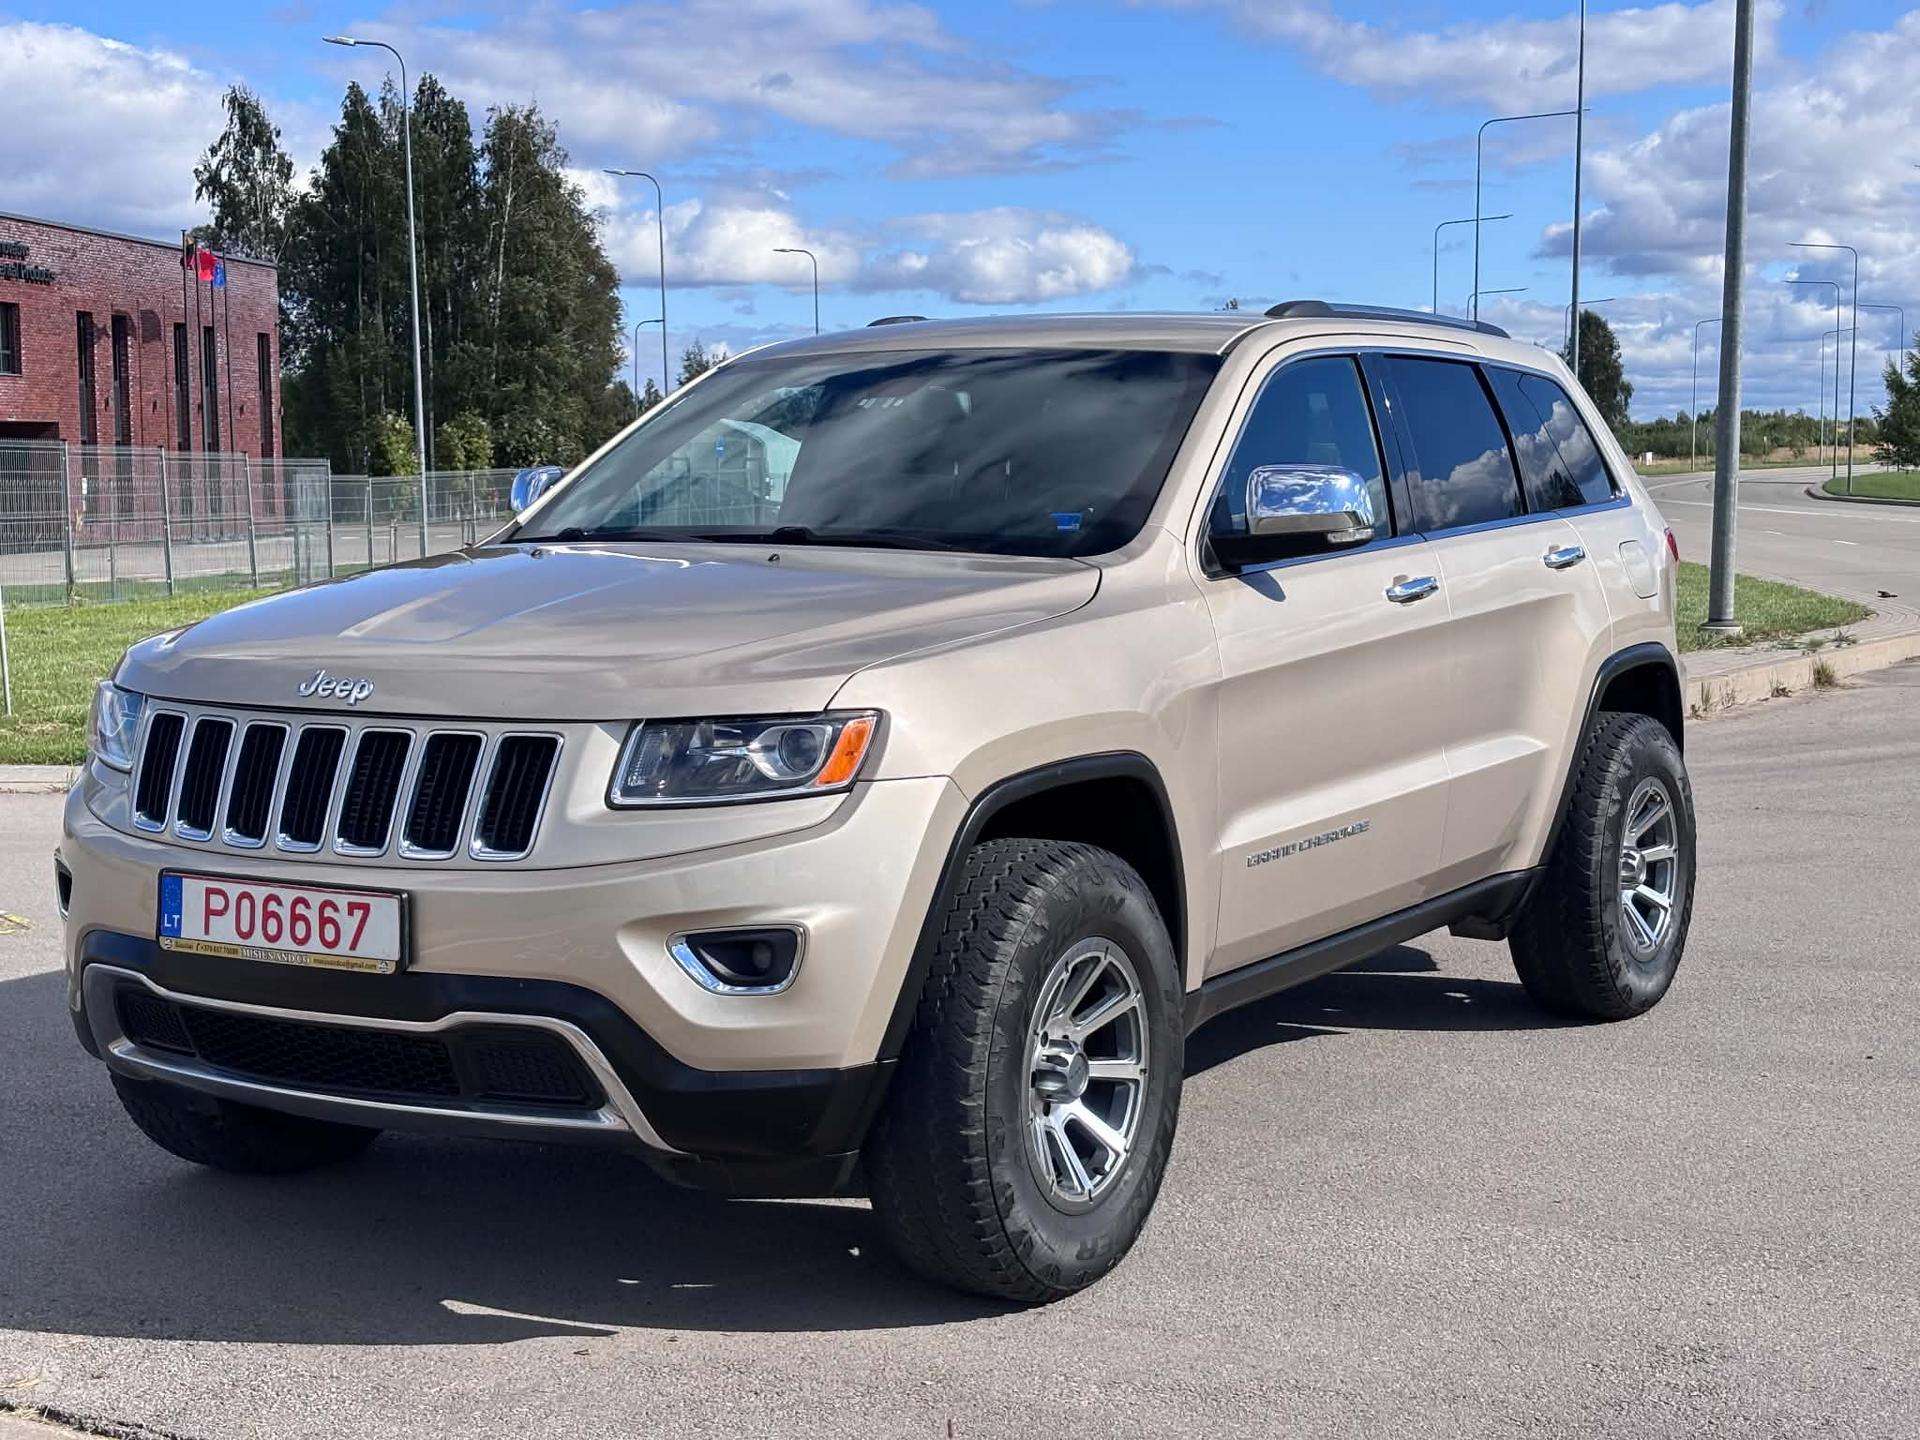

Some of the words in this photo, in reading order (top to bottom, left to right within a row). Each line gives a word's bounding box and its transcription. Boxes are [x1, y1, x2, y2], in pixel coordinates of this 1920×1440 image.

[299, 670, 375, 706] Jeep
[1246, 841, 1298, 868] GRAND
[1298, 820, 1370, 853] CHEROKEE
[164, 912, 180, 929] LT
[203, 886, 371, 951] P06667
